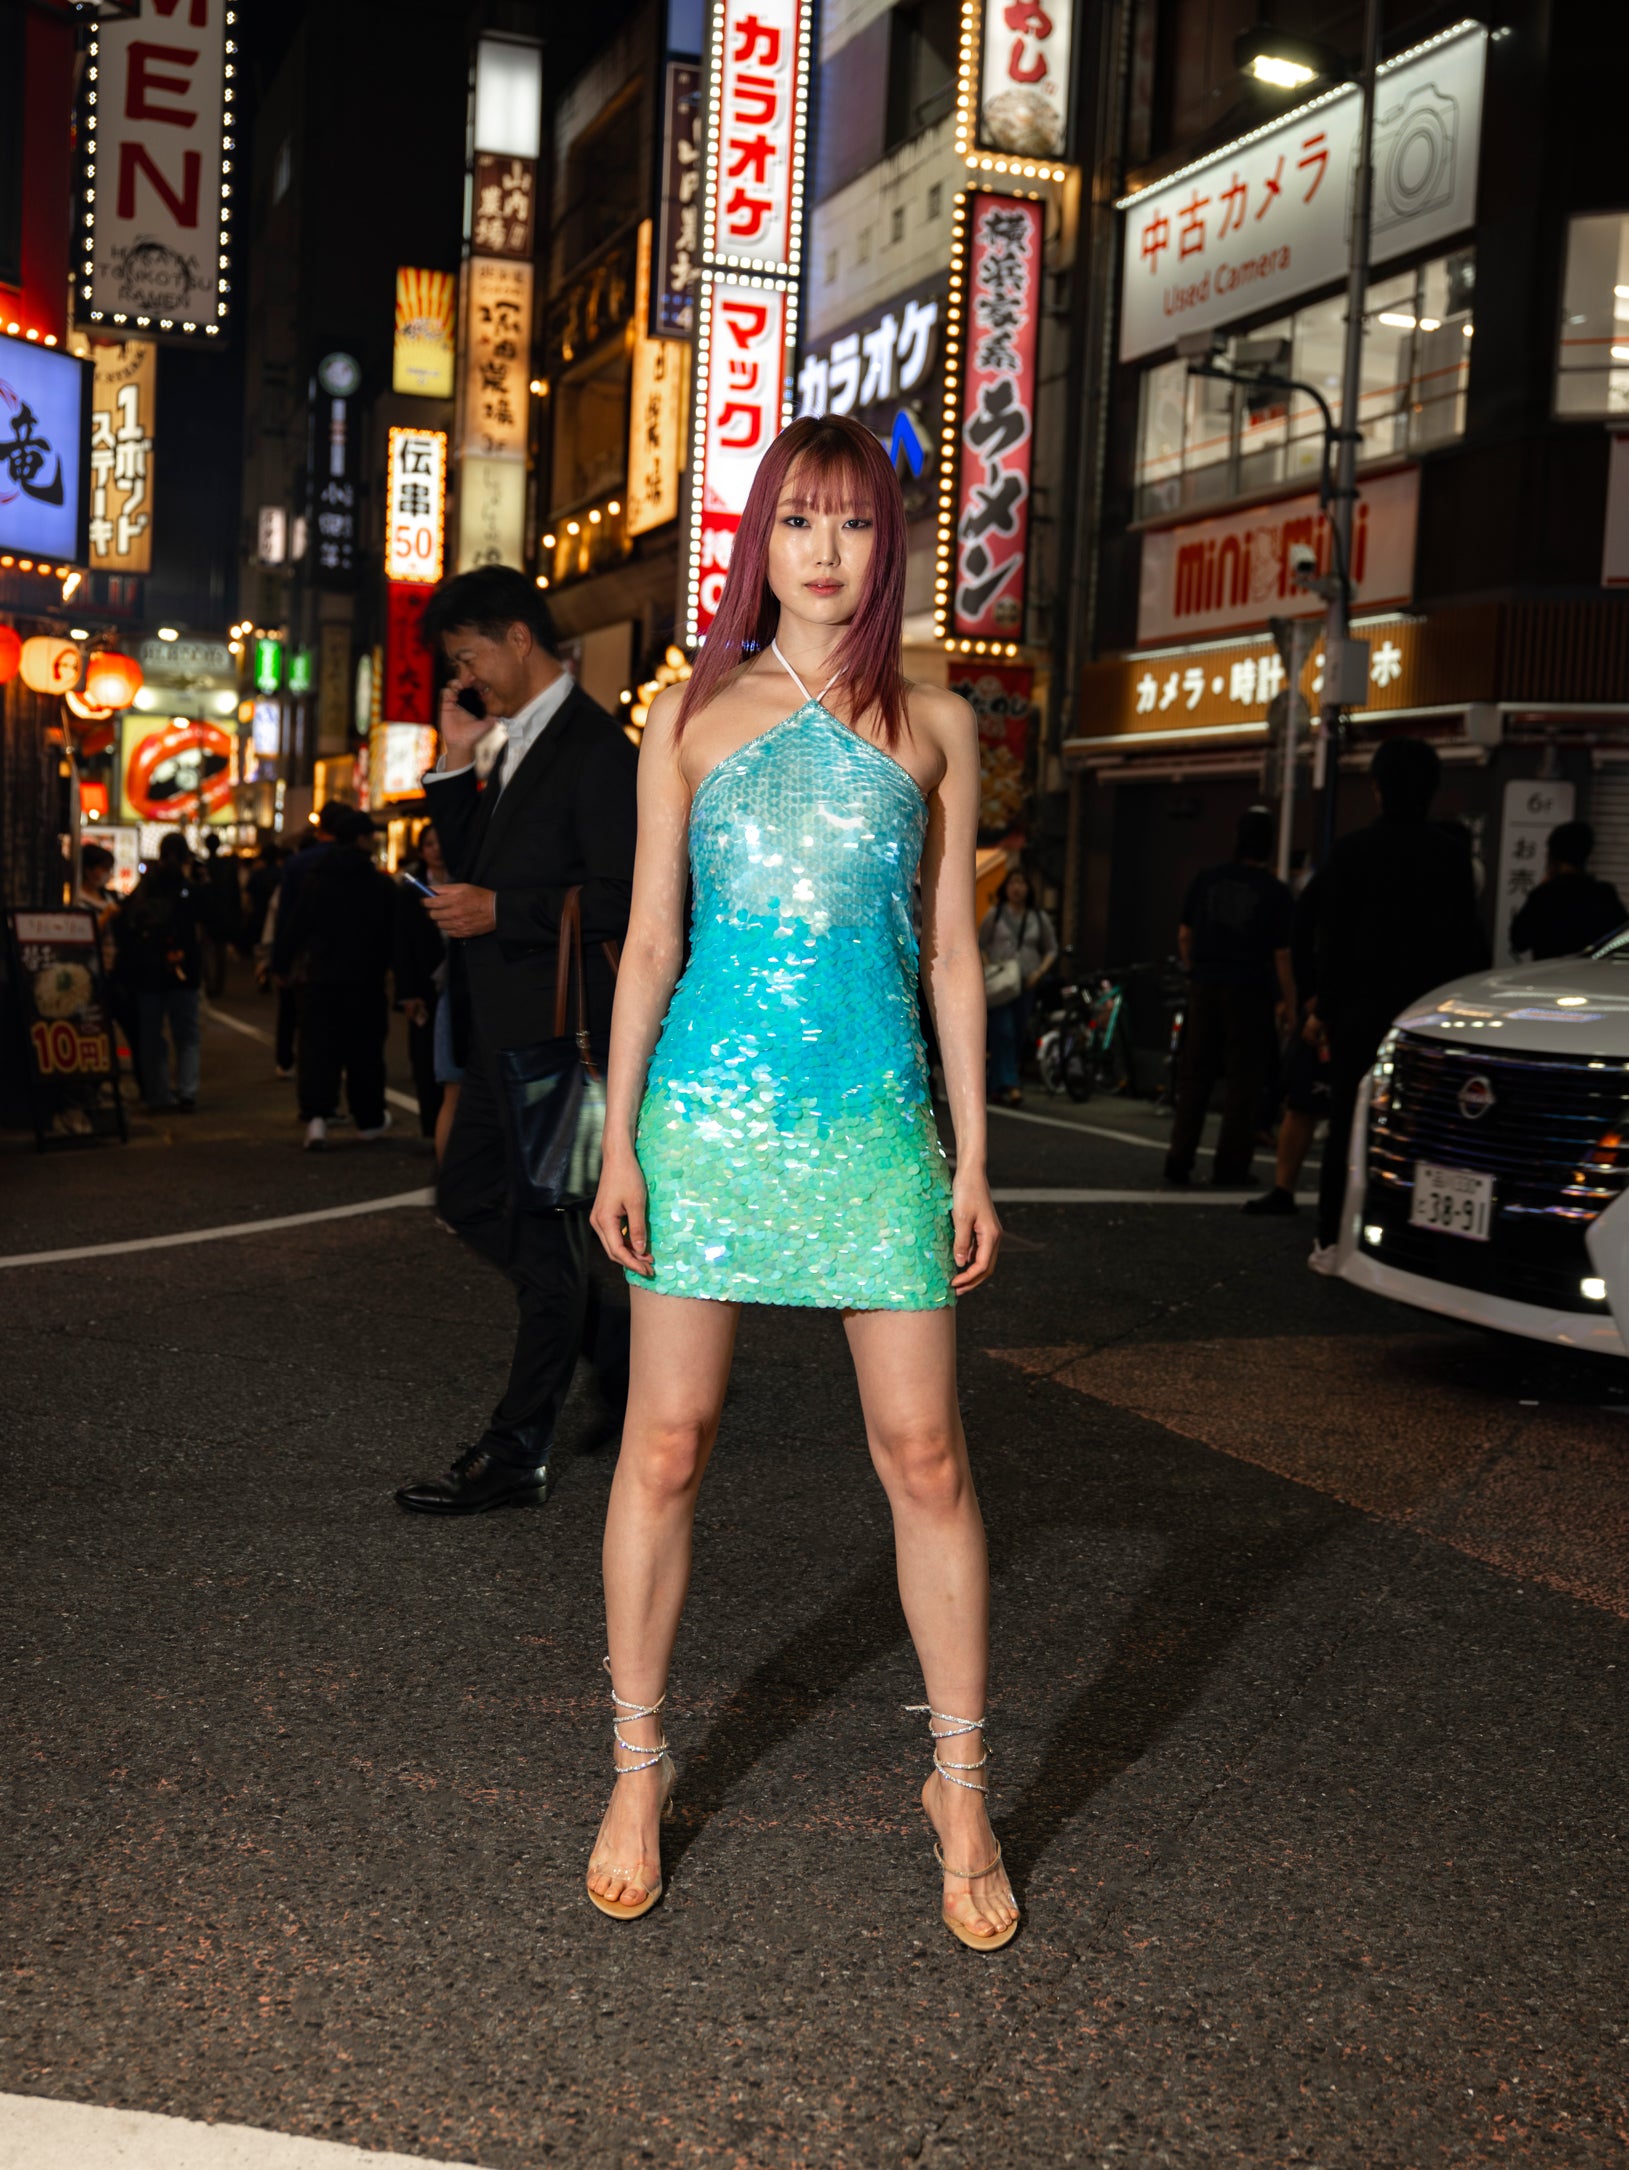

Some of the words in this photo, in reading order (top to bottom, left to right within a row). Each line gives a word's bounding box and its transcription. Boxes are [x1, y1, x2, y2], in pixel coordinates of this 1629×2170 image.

[725, 13, 780, 238] カラオケ
[1141, 132, 1329, 276] 中古カメラ
[1162, 269, 1210, 317] Used
[1213, 243, 1291, 295] Camera
[717, 301, 768, 450] マック
[797, 299, 938, 418] カラオケ
[89, 411, 117, 556] ステーキ
[399, 438, 432, 518] 伝串
[395, 525, 433, 560] 50
[1174, 532, 1253, 618] mini
[1277, 503, 1369, 599] mii
[31, 1020, 110, 1073] 10円!
